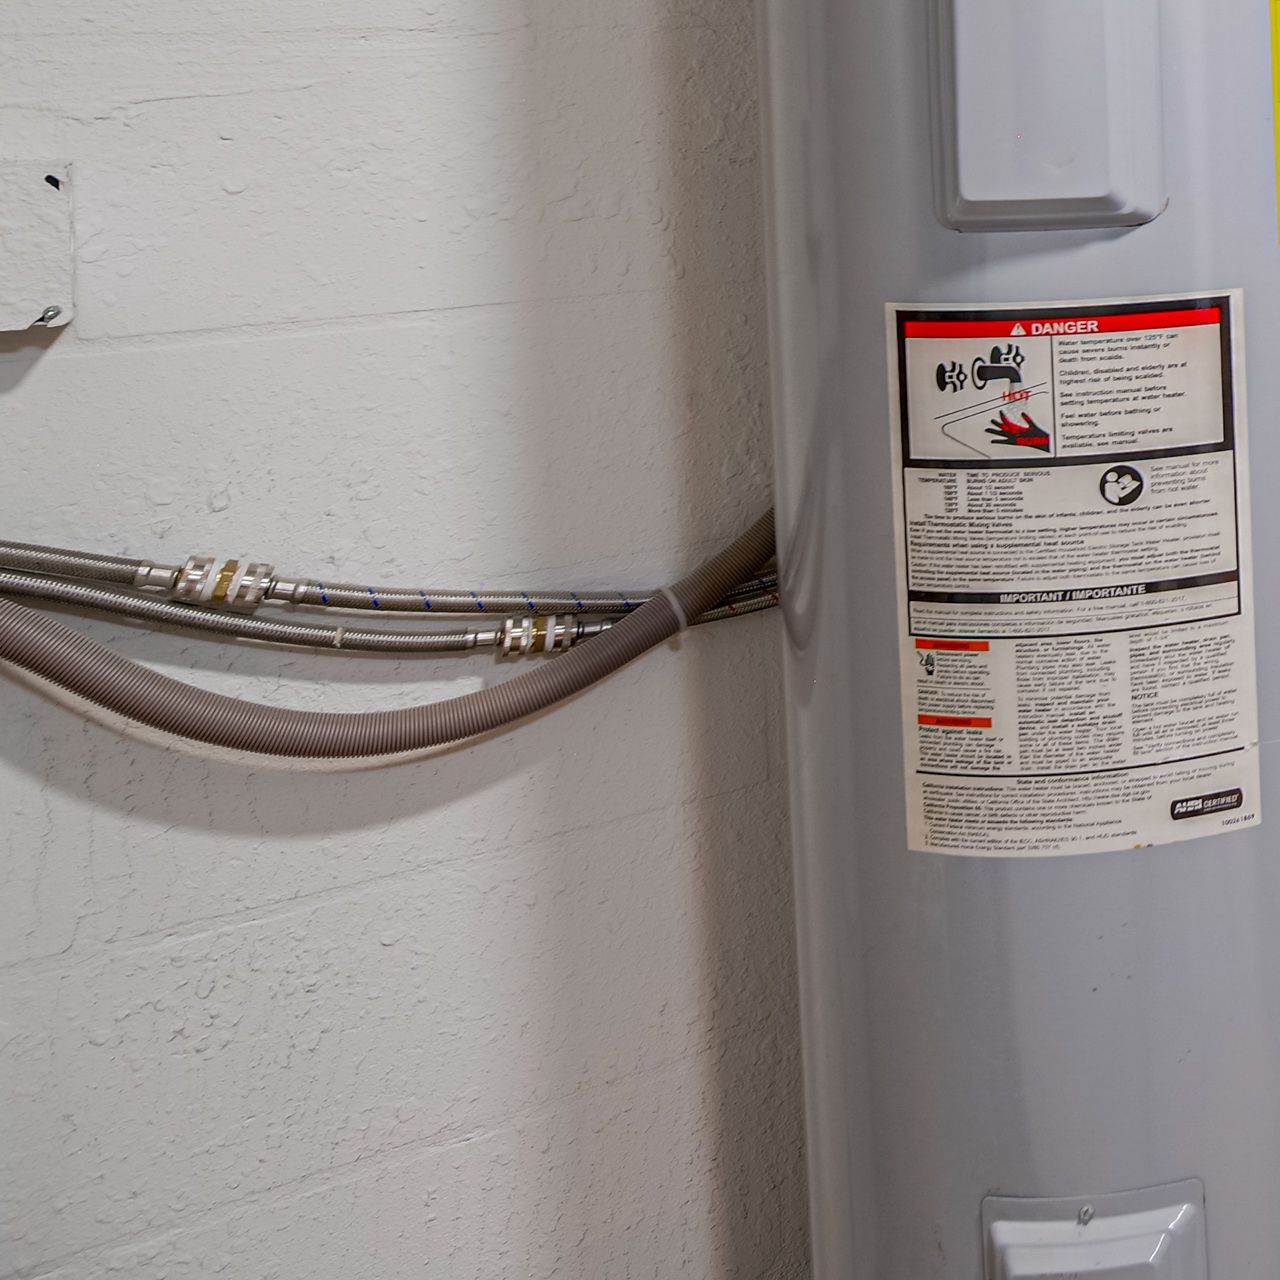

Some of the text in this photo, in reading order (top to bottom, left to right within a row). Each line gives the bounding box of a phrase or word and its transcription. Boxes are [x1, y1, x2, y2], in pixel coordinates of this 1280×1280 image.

[1031, 320, 1099, 336] DANGER
[1000, 592, 1064, 603] IMPORTANT
[1072, 584, 1147, 600] IMPORTANTE
[1131, 691, 1158, 700] NOTICE
